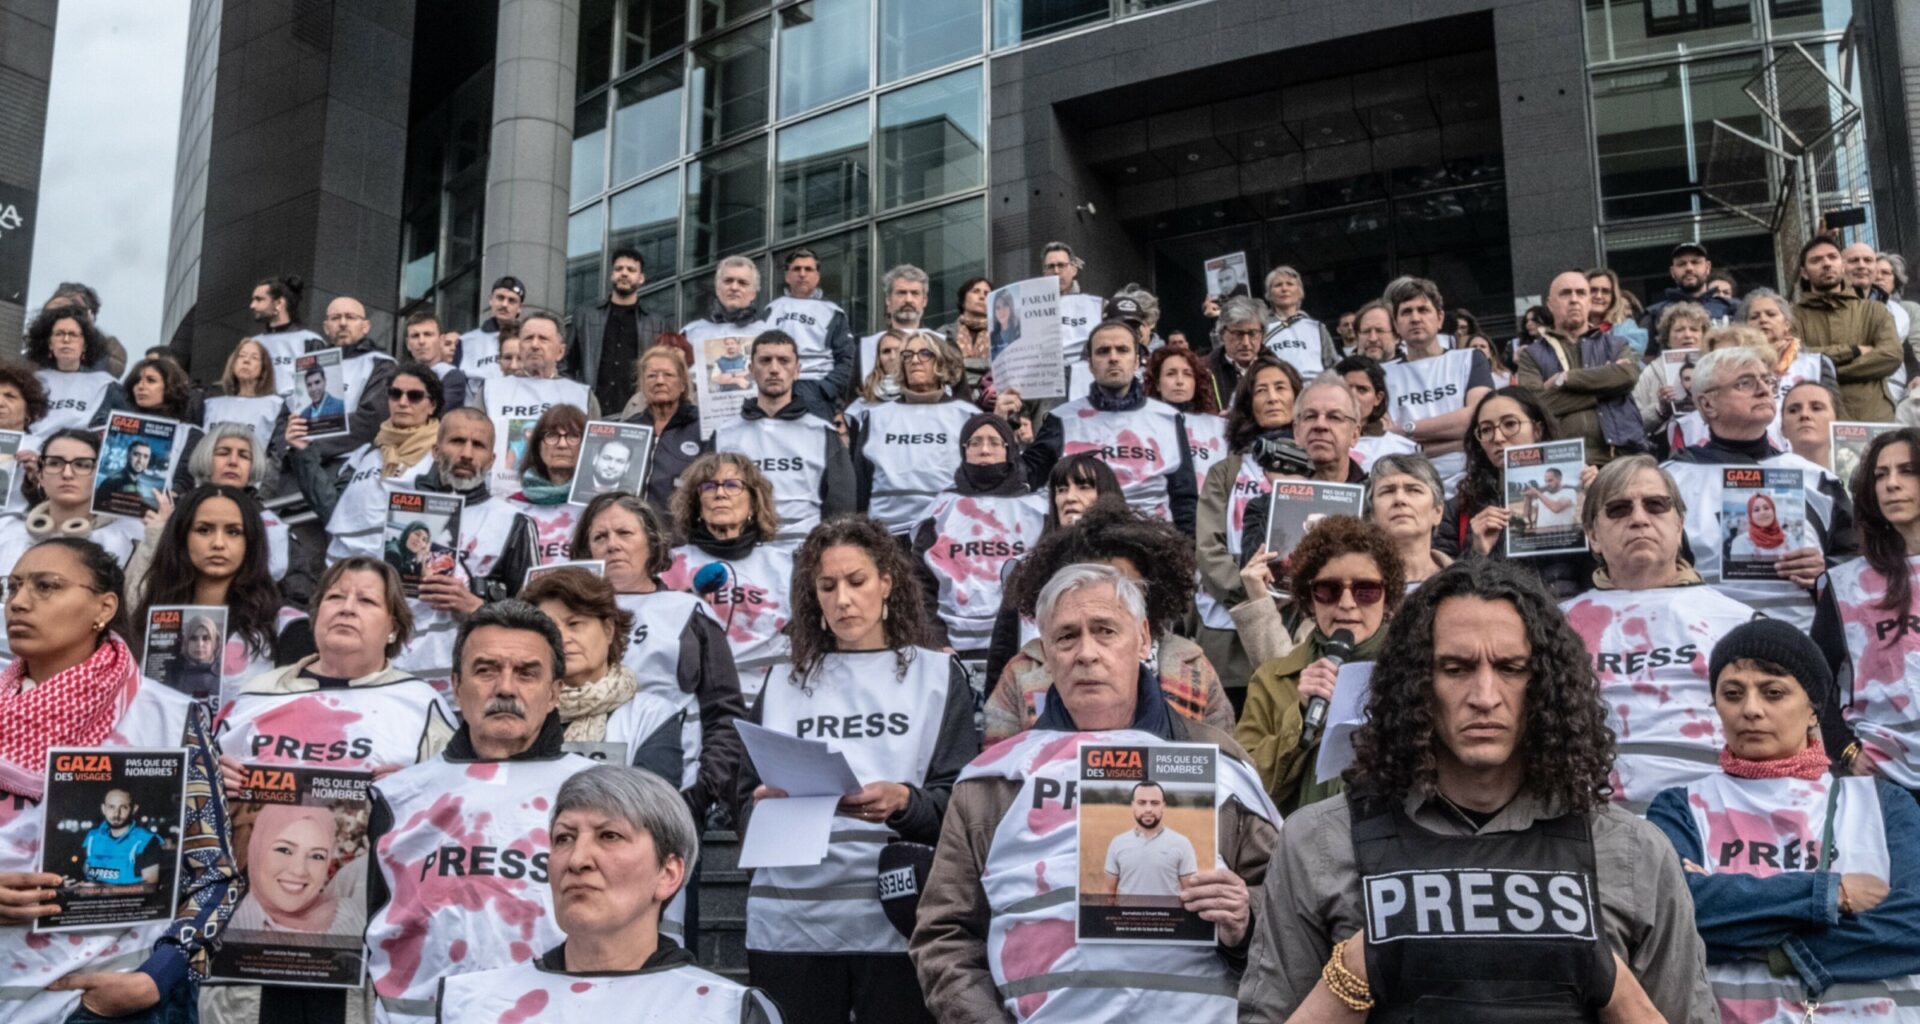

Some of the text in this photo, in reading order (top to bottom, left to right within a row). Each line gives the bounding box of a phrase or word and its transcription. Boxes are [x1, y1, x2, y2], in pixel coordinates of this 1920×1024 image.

[1022, 293, 1056, 306] FARAH
[776, 312, 816, 326] PRESS
[1024, 307, 1056, 319] OMAR
[1061, 316, 1088, 327] ESS
[1397, 383, 1458, 407] PRESS
[112, 416, 140, 429] GAZA
[1836, 426, 1867, 437] GAZA
[885, 433, 948, 444] PRESS
[1101, 445, 1157, 462] RESS
[1509, 448, 1541, 461] GAZA
[750, 456, 804, 472] RESS
[1726, 469, 1761, 481] GAZA
[1279, 484, 1314, 497] GAZA
[391, 494, 422, 506] GAZA
[949, 541, 1025, 559] PRESS
[714, 586, 763, 605] ESS
[152, 611, 180, 624] GAZA
[1597, 644, 1697, 675] RESS
[796, 713, 910, 739] PRESS
[251, 734, 374, 762] PRESS
[55, 755, 112, 772] GAZA
[125, 758, 178, 767] PAS QUE DES
[1087, 750, 1143, 768] GAZA
[1155, 754, 1209, 765] PAS QUE DES
[124, 767, 172, 777] NOMBRES
[1086, 768, 1143, 778] DES VISAGES
[1155, 764, 1204, 775] NOMBRES
[54, 772, 112, 782] DES VISAGES
[312, 776, 331, 788] PAS
[332, 778, 353, 790] QUE
[254, 790, 297, 802] VISAGES
[311, 788, 366, 801] NOMBRES
[879, 869, 914, 896] PRESS
[1370, 872, 1588, 938] PRESS
